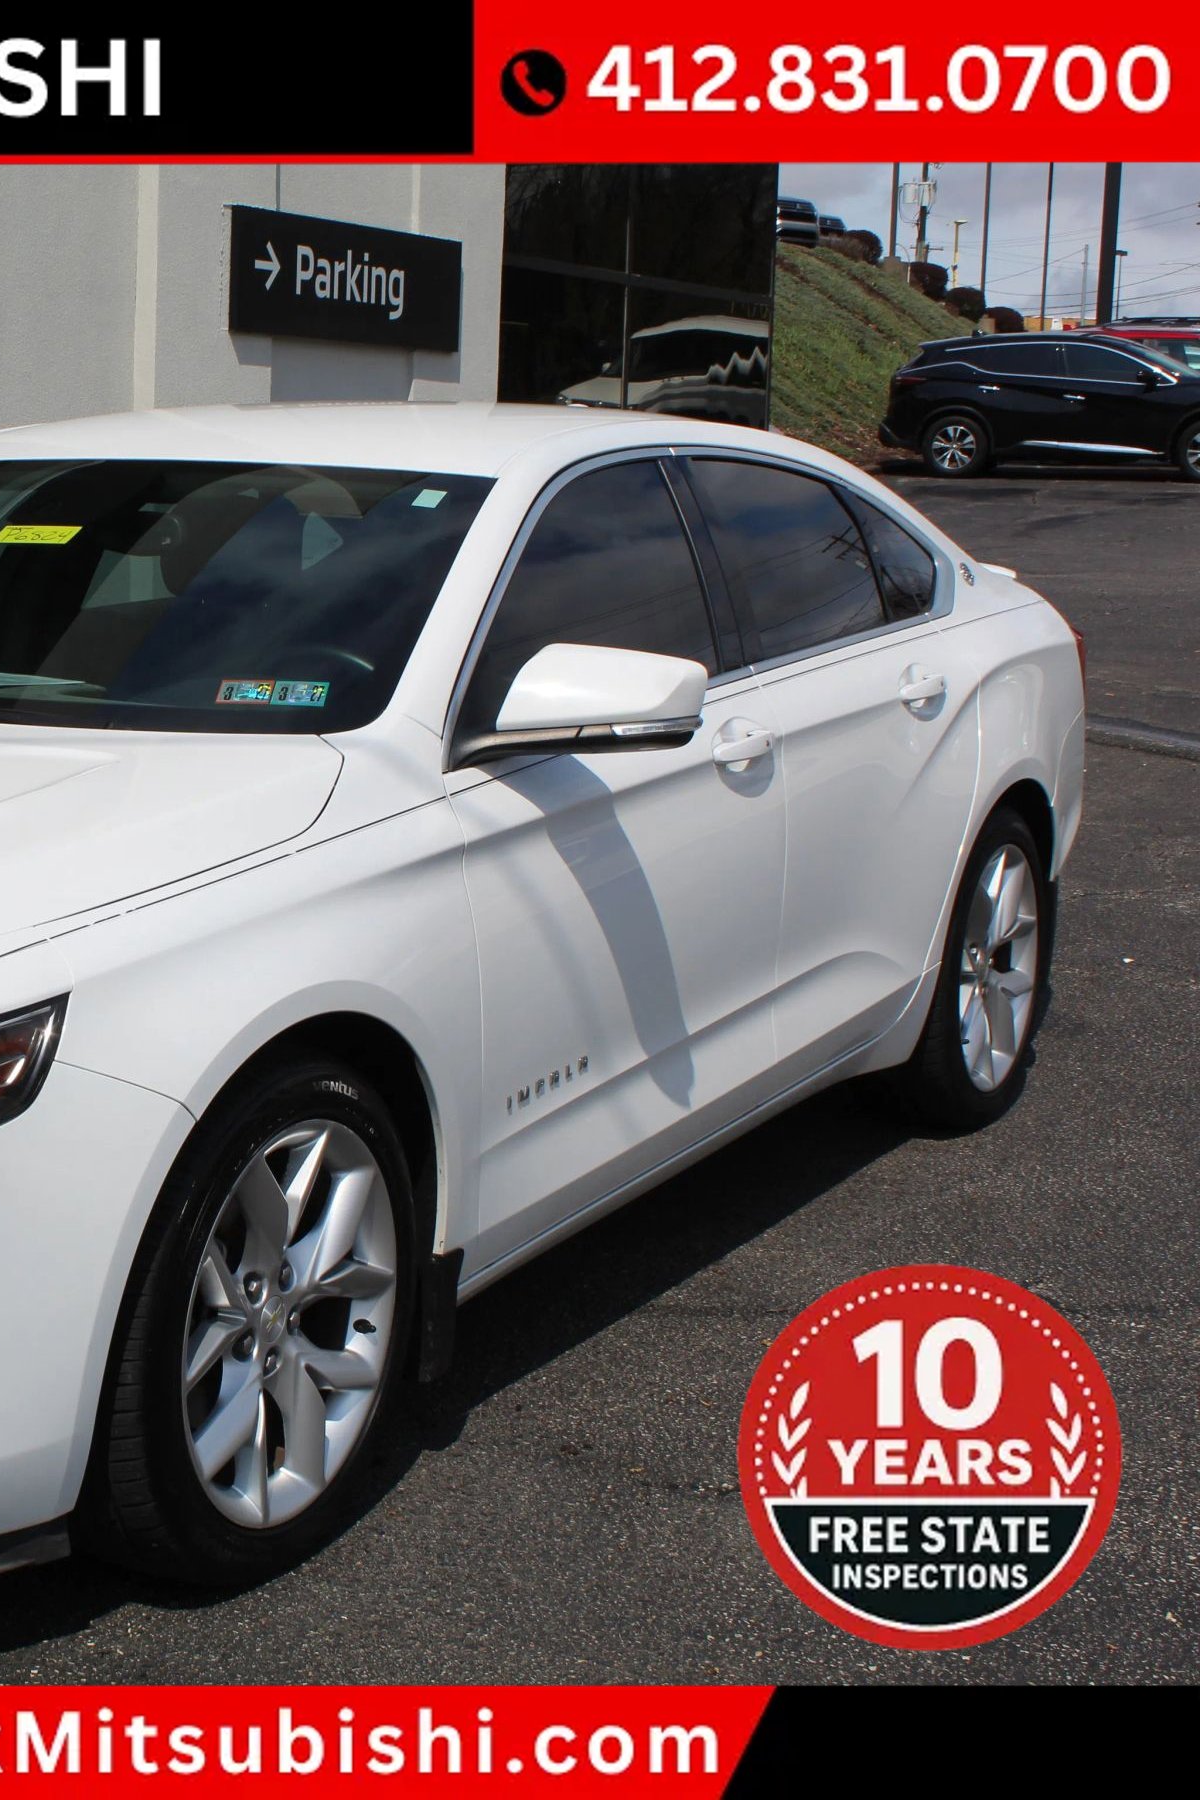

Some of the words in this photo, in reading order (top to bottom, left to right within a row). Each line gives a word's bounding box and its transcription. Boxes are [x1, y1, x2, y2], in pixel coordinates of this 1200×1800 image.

[295, 244, 406, 320] Parking
[223, 686, 234, 701] 3
[278, 686, 289, 701] 3
[506, 1055, 588, 1110] IMPALA
